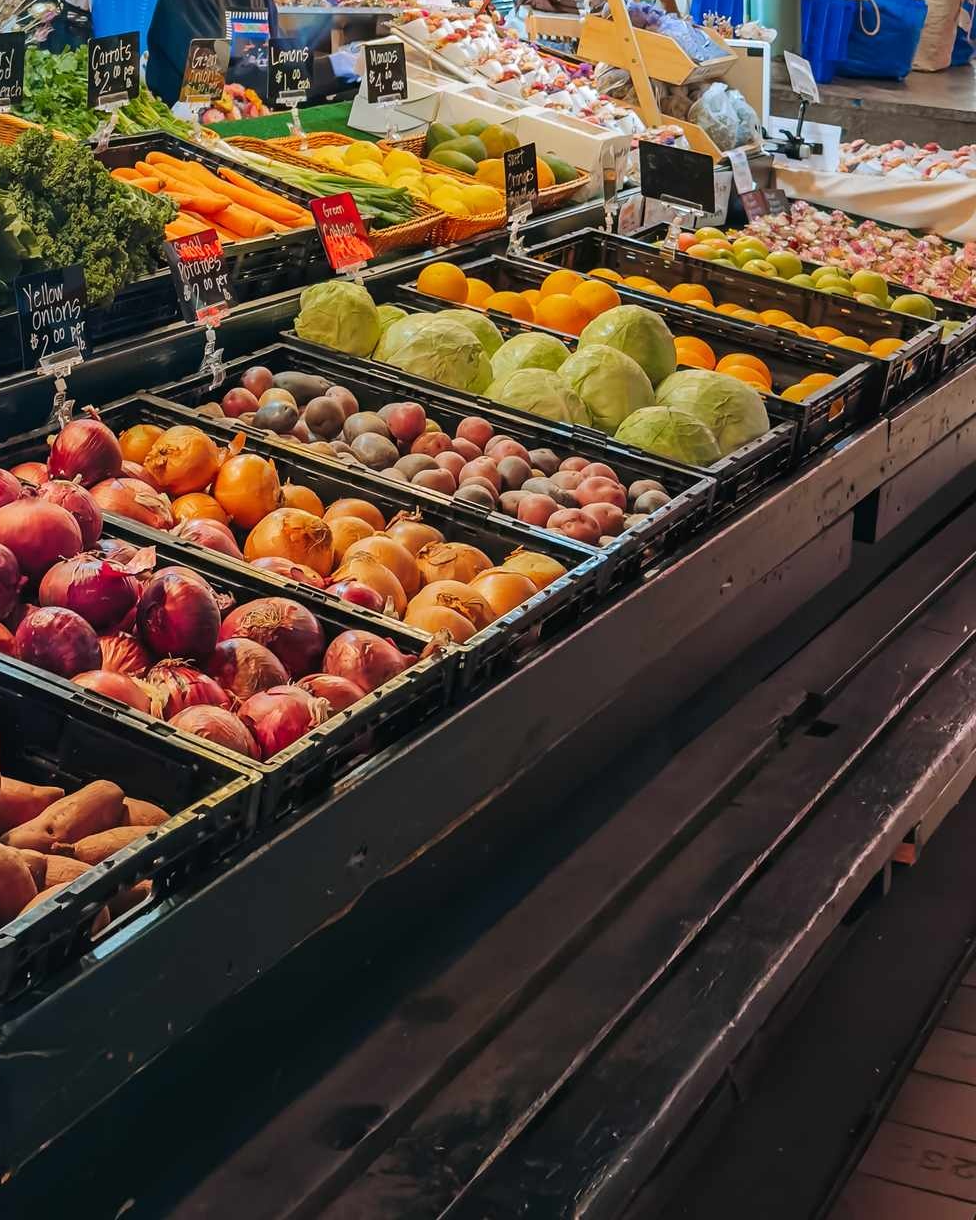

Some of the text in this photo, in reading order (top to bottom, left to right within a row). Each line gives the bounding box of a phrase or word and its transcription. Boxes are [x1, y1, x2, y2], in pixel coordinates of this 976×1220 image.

[91, 39, 132, 71] Carrots
[270, 46, 310, 66] Lemons
[369, 48, 399, 71] Mangos
[215, 273, 229, 293] per
[22, 281, 64, 312] Yellow
[70, 321, 86, 343] per
